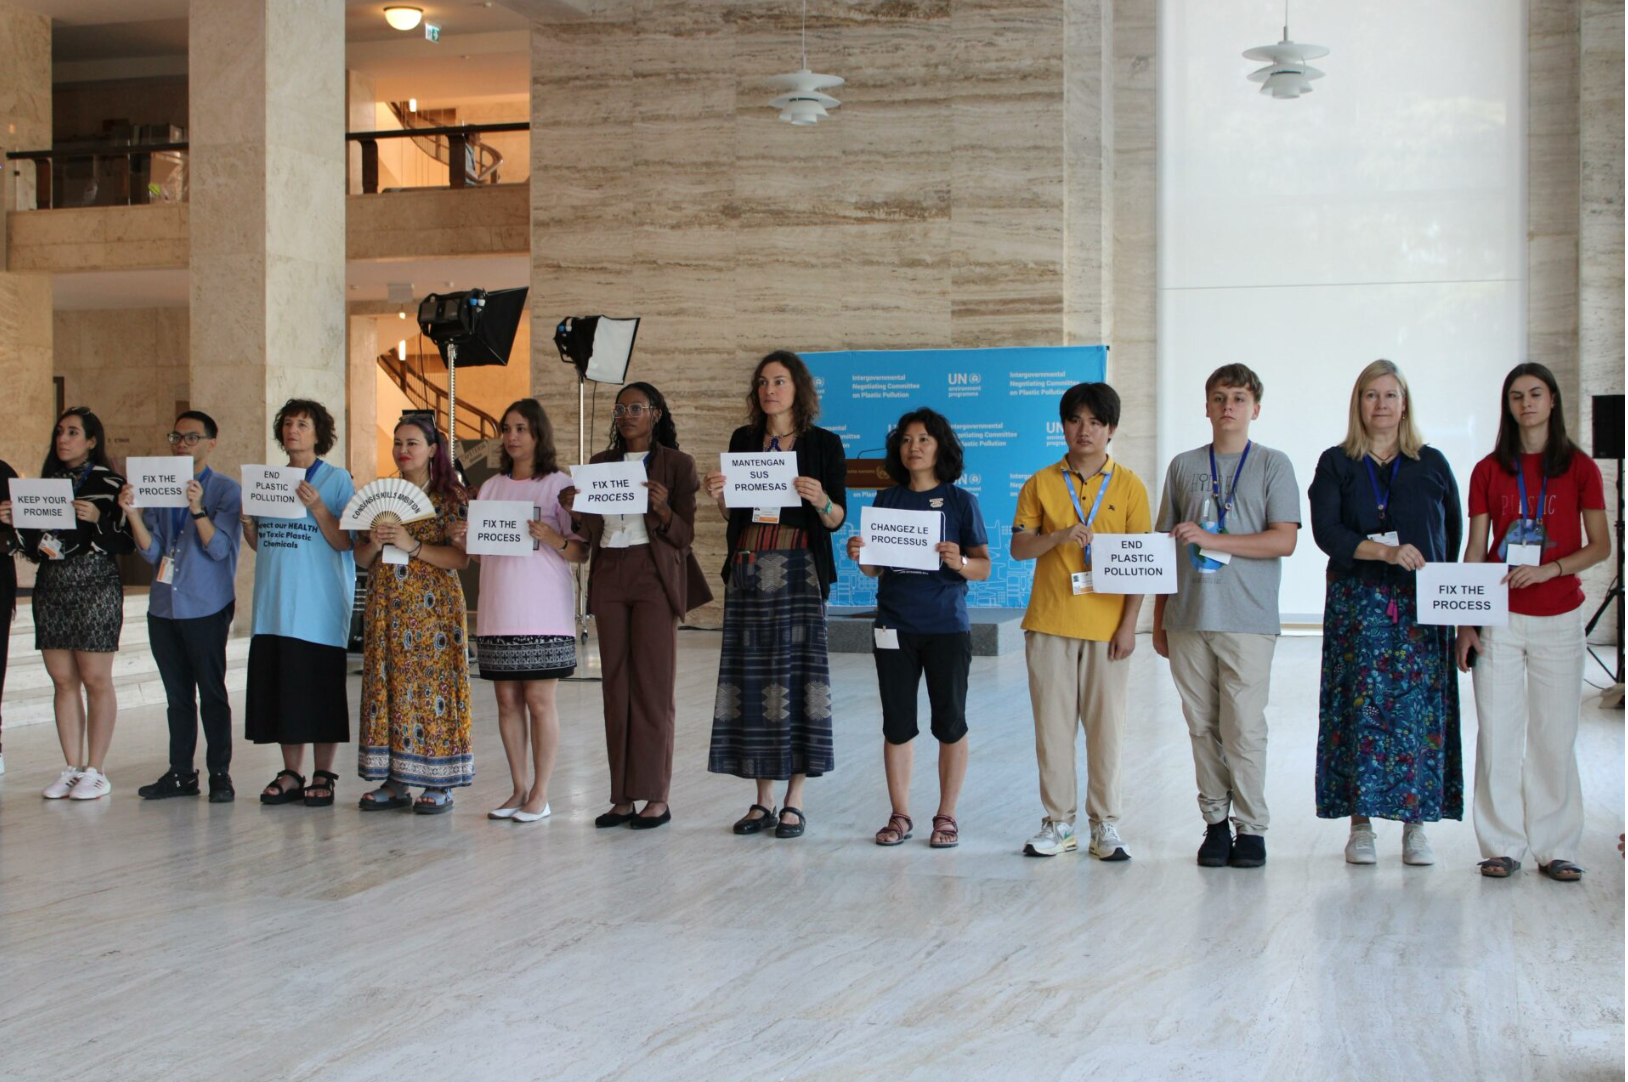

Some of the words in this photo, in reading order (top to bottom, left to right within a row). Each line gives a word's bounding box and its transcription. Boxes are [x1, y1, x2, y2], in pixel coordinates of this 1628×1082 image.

[852, 374, 906, 382] Intergovernmental
[948, 373, 967, 385] UN
[1009, 371, 1066, 379] Intergovernmental
[852, 383, 887, 391] Negotiating
[1009, 380, 1046, 388] Negotiating
[731, 459, 785, 467] MANTENGAN
[142, 475, 157, 483] FIX
[159, 475, 176, 483] THE
[264, 471, 280, 479] END
[750, 471, 769, 479] SUS
[256, 482, 289, 491] PLASTIC
[592, 480, 608, 489] FIX
[610, 479, 630, 488] THE
[735, 483, 787, 491] PROMESAS
[139, 487, 182, 495] PROCESS
[380, 491, 397, 499] KILLS
[18, 496, 40, 504] KEEP
[42, 496, 67, 504] YOUR
[250, 493, 295, 503] POLLUTION
[588, 492, 635, 502] PROCESS
[24, 508, 63, 517] PROMISE
[288, 522, 318, 533] HEALTH
[483, 519, 496, 528] FIX
[499, 520, 517, 529] THE
[870, 522, 915, 534] CHANGEZ
[917, 526, 929, 535] LE
[267, 530, 284, 538] Toxic
[286, 531, 312, 541] Plastic
[477, 533, 521, 542] PROCESS
[263, 540, 298, 549] Chemicals
[871, 535, 928, 547] PROCESSUS
[1121, 540, 1143, 549] END
[1111, 554, 1154, 563] PLASTIC
[1104, 567, 1163, 576] POLLUTION
[1439, 585, 1457, 595] FIX
[1461, 585, 1485, 595] THE
[1433, 600, 1491, 610] PROCESS
